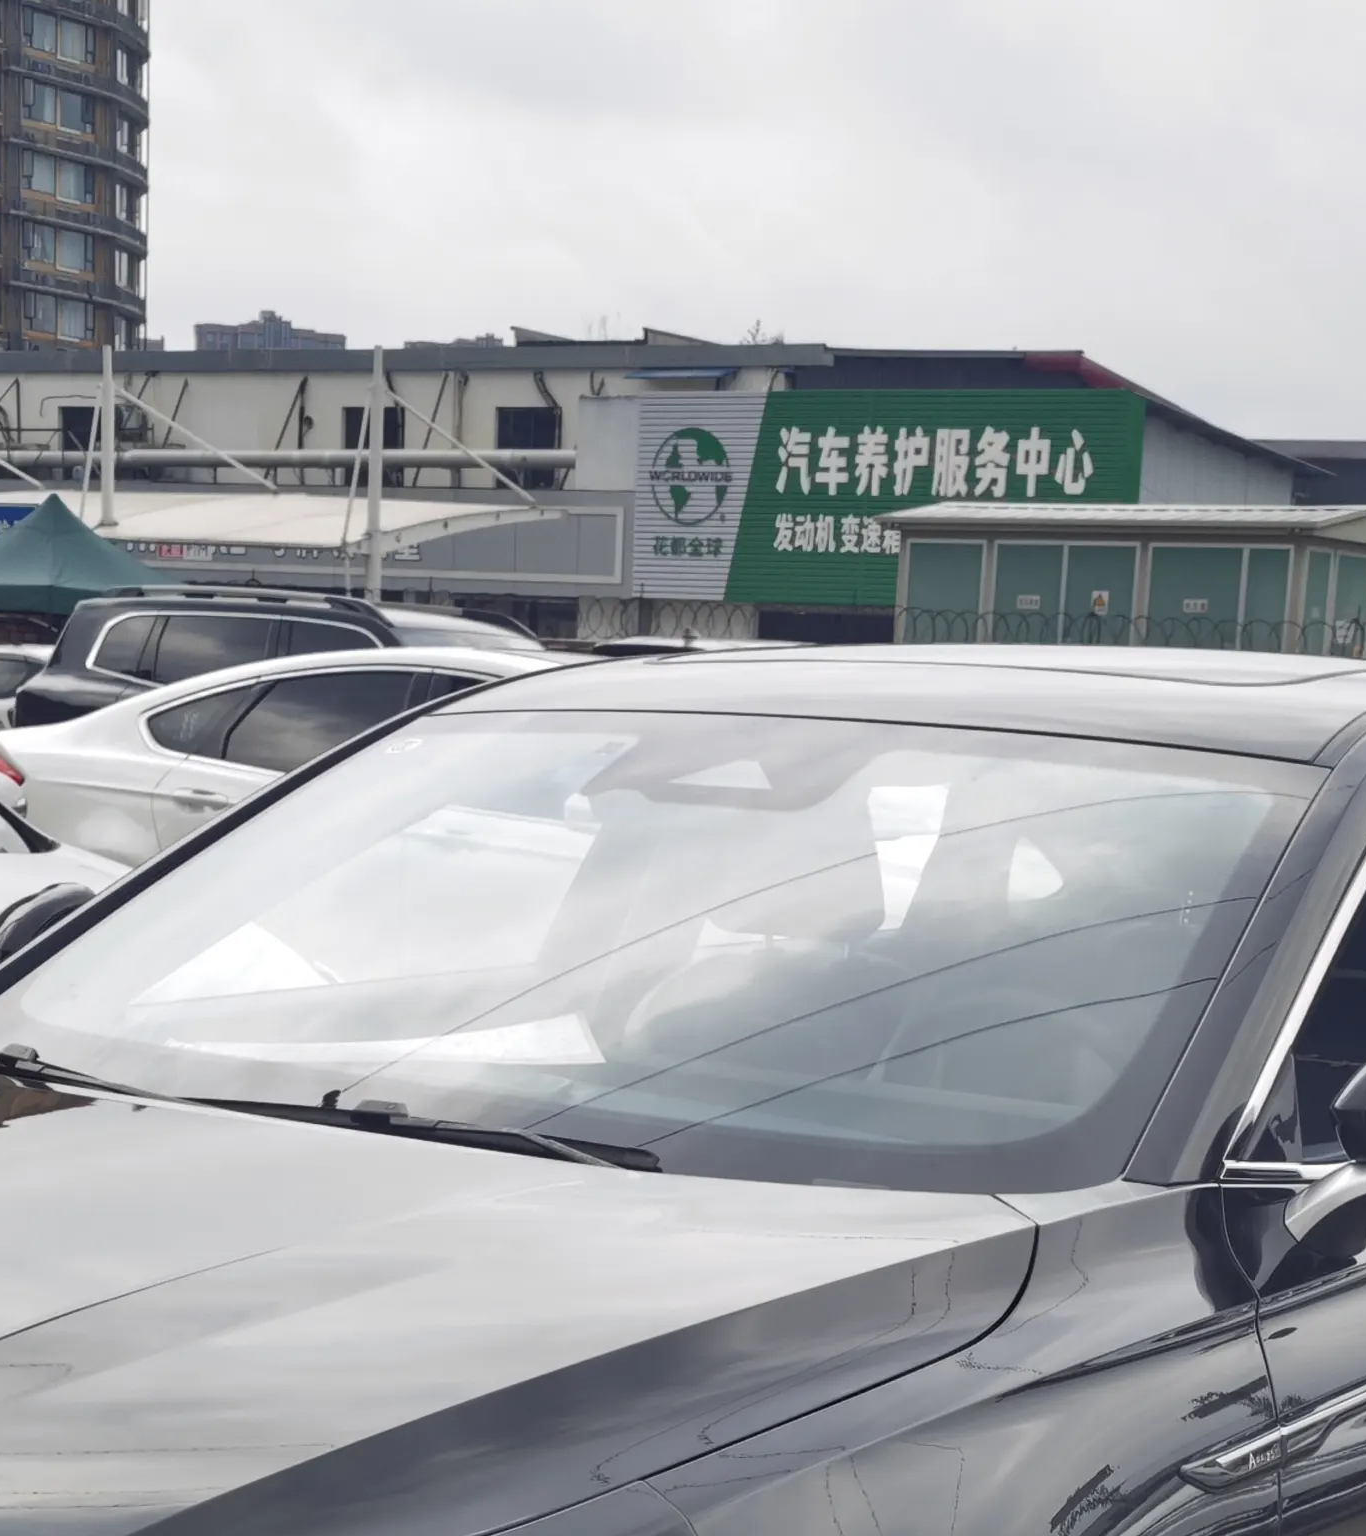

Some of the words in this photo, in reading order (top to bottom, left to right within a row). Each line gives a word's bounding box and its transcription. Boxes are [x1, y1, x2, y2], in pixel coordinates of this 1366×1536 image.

[648, 470, 733, 483] WORLDWIDE
[776, 425, 1094, 498] 汽车养护服务中心
[773, 513, 836, 553] 发动机
